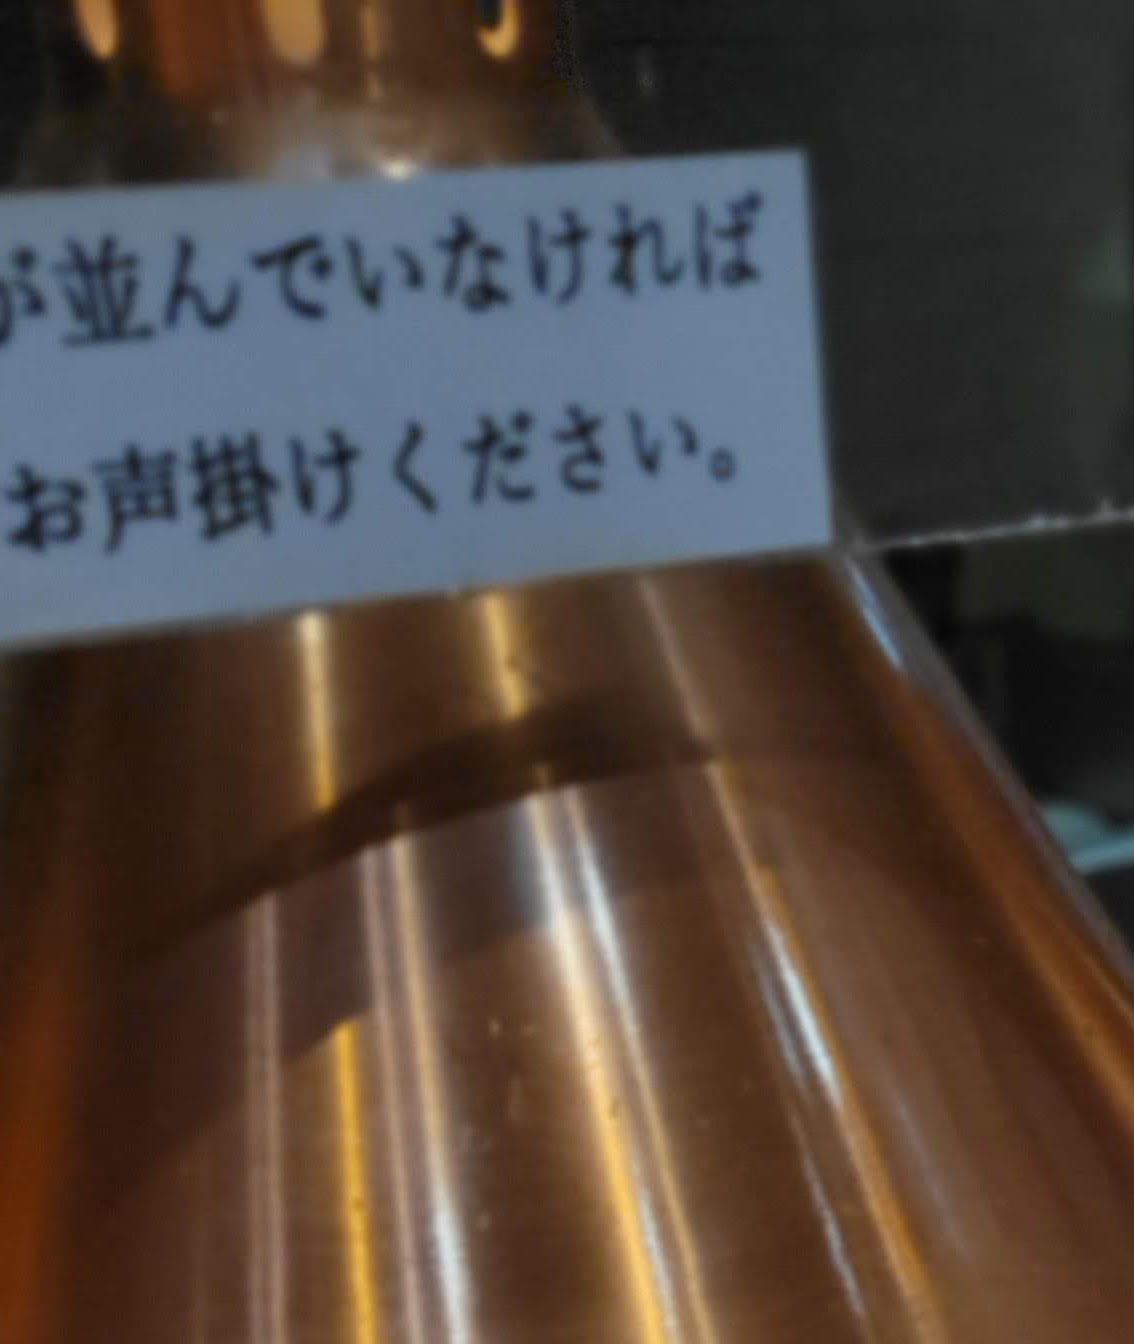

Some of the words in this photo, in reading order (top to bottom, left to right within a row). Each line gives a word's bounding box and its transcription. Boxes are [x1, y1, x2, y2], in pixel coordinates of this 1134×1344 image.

[4, 402, 737, 553] お声掛けください。
